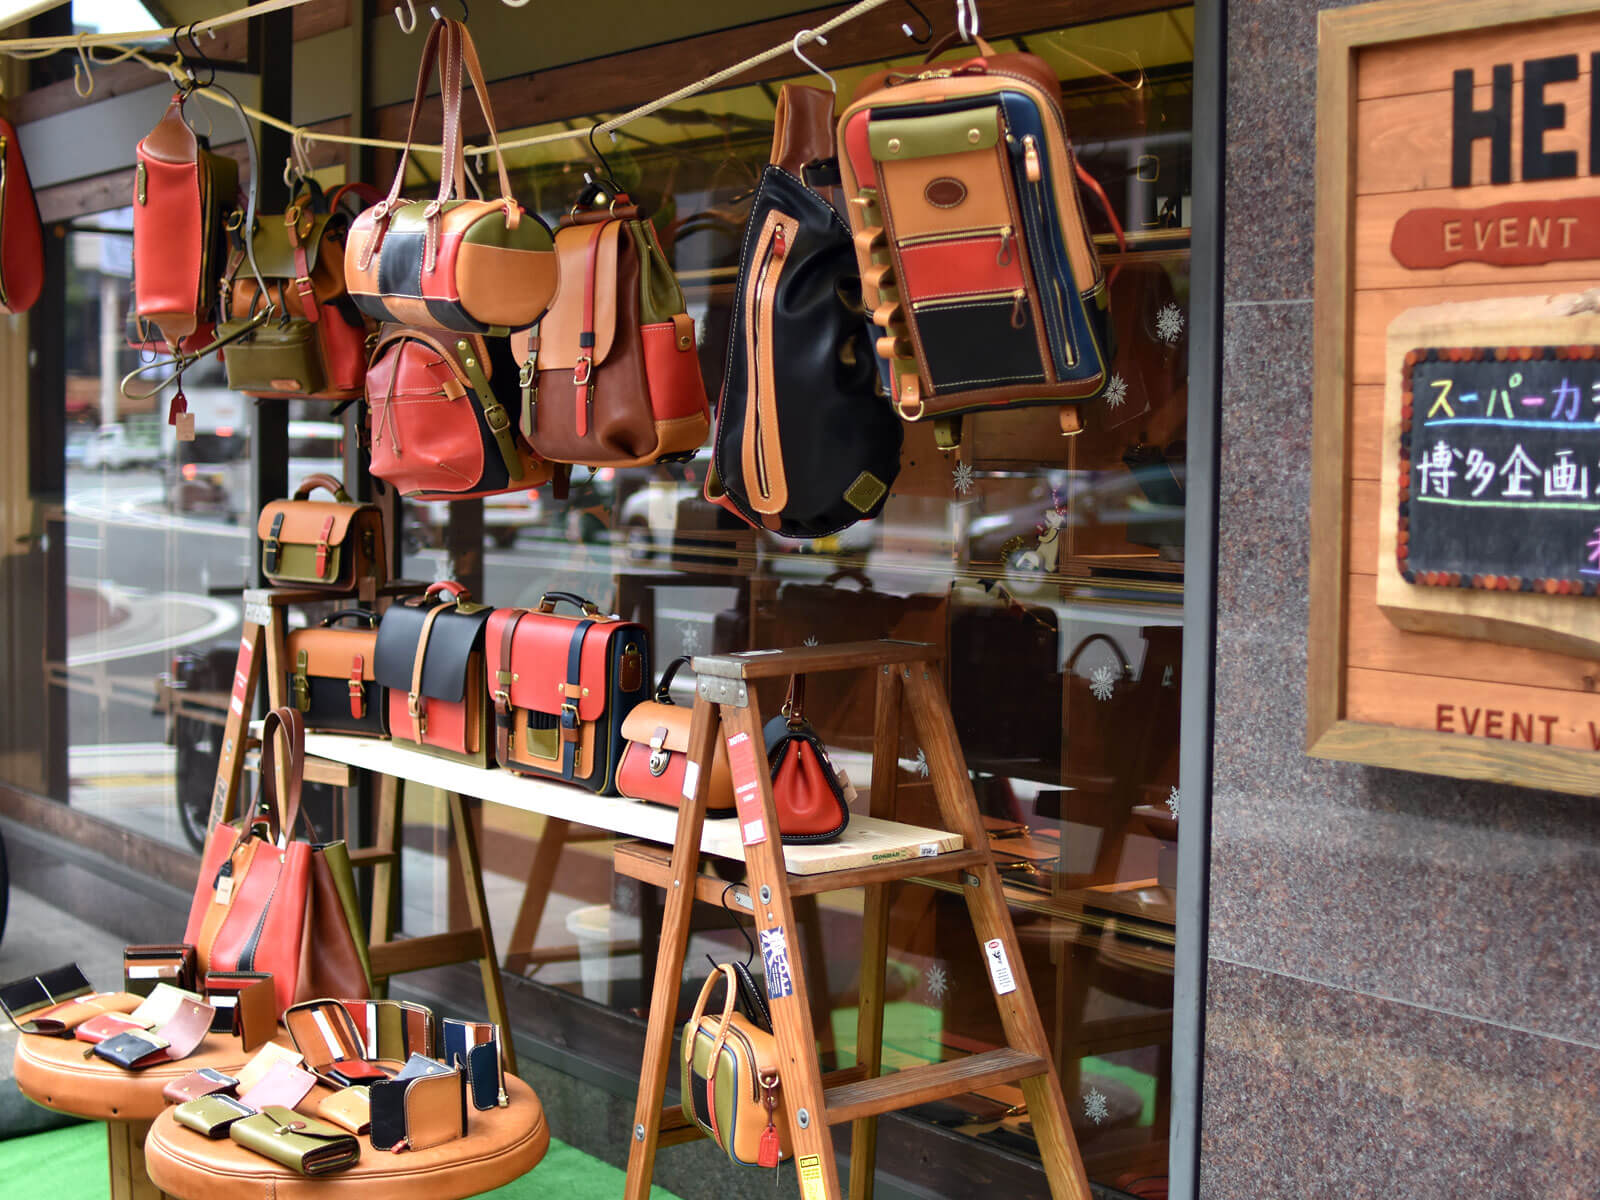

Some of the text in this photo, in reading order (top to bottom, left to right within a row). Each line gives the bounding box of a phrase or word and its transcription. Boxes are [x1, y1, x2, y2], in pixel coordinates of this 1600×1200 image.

[1444, 216, 1578, 251] EVENT
[1427, 373, 1600, 423] スーパーカ
[1416, 440, 1600, 499] 博多企画
[1436, 703, 1559, 746] EVENT
